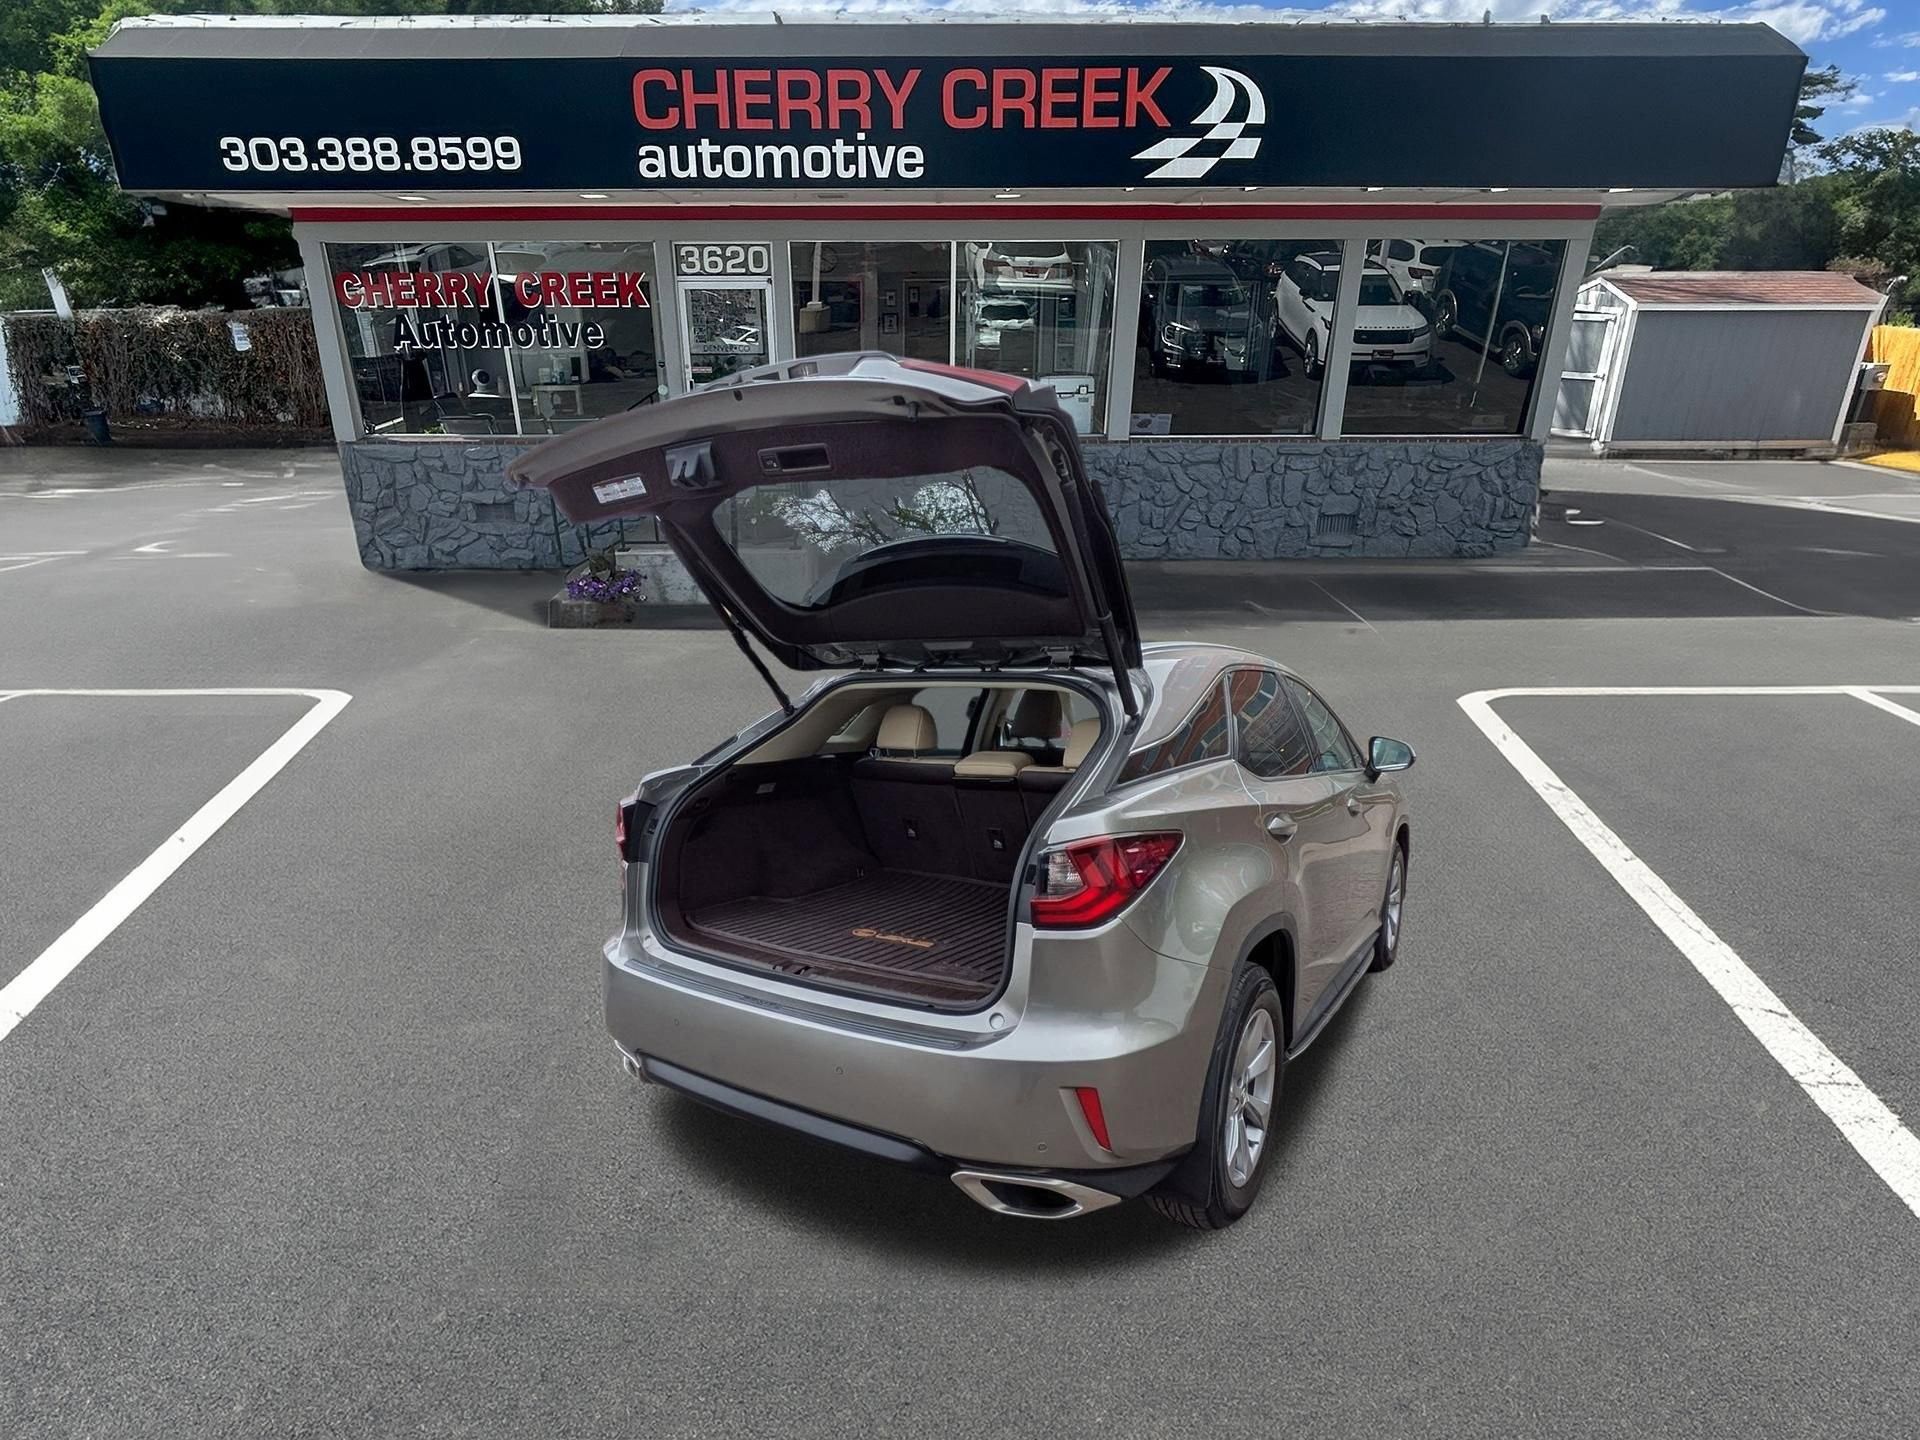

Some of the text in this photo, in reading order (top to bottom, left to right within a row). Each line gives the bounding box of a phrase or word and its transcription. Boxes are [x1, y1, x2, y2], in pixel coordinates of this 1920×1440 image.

[633, 67, 1171, 129] CHERRY CREEK
[219, 136, 522, 172] 303.388.8599
[638, 132, 924, 179] automotive
[680, 246, 768, 273] 3620
[334, 271, 650, 309] CHERRY CREEK
[393, 313, 605, 350] Automotive
